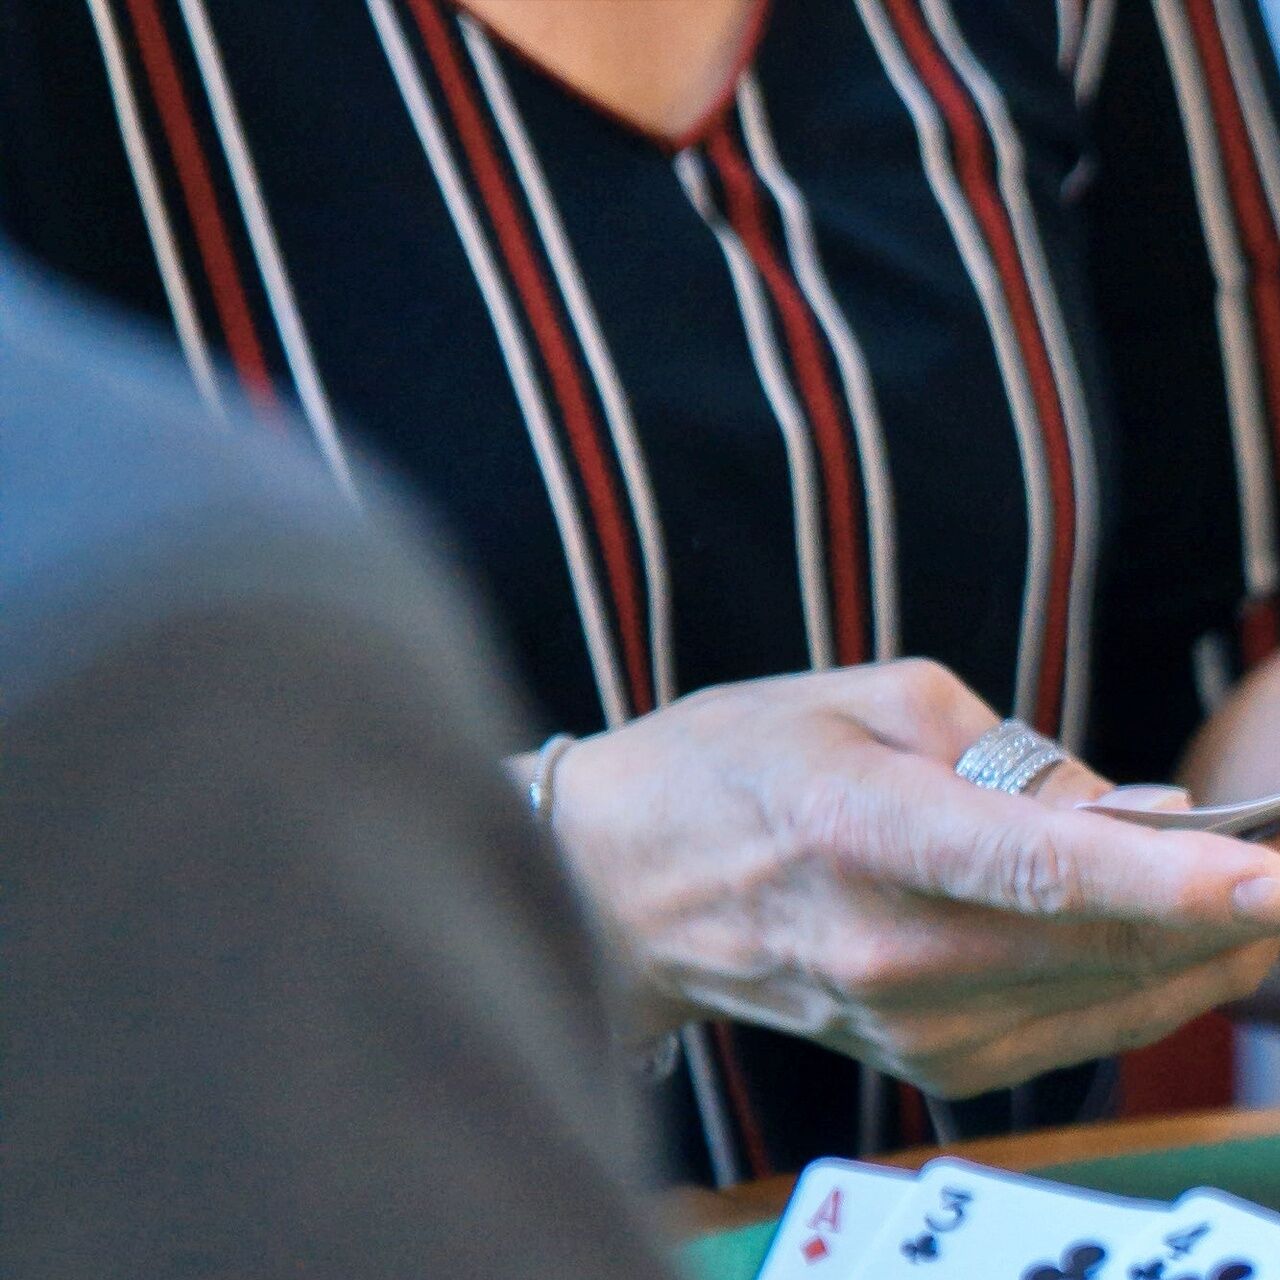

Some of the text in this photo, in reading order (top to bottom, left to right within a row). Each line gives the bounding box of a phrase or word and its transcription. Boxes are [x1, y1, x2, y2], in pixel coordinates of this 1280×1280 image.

[807, 1187, 841, 1234] A
[924, 1185, 974, 1233] 3
[1163, 1220, 1211, 1260] 4
